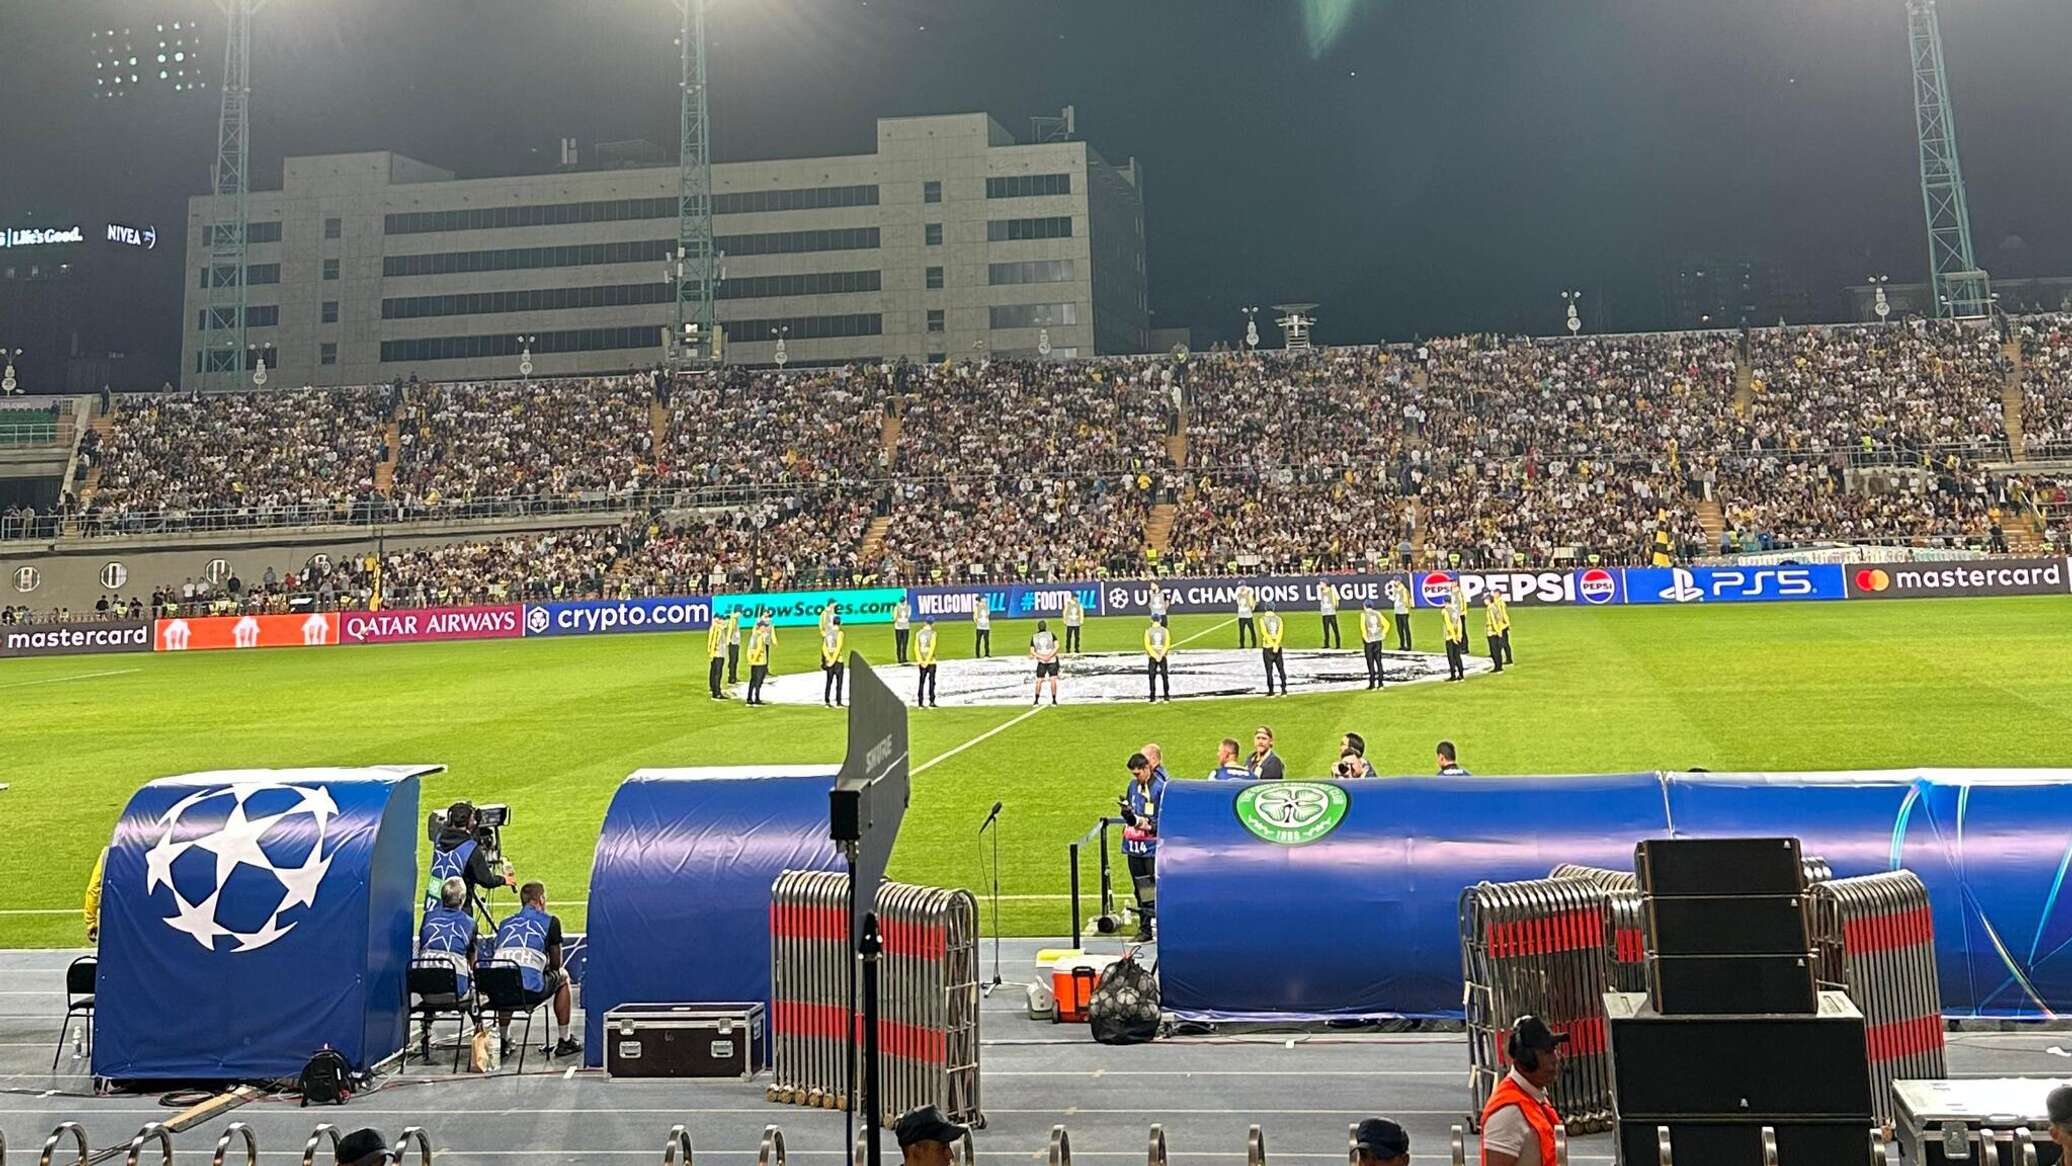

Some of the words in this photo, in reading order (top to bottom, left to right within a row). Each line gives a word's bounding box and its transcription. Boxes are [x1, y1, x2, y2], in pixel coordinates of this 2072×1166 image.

[107, 224, 141, 245] NIVEA
[1458, 572, 1576, 603] PEPSI
[1582, 582, 1612, 590] PEPSI
[1711, 570, 1812, 596] PS5
[1896, 564, 2061, 588] mastercard
[1134, 587, 1184, 606] UFA
[1187, 584, 1299, 605] CHAMIONS
[1424, 585, 1453, 594] PEPS
[347, 615, 418, 641] QATAR
[426, 610, 516, 633] AIRWAYS
[557, 603, 710, 632] crypto.com
[7, 625, 148, 649] mastercard
[1128, 839, 1148, 854] 114
